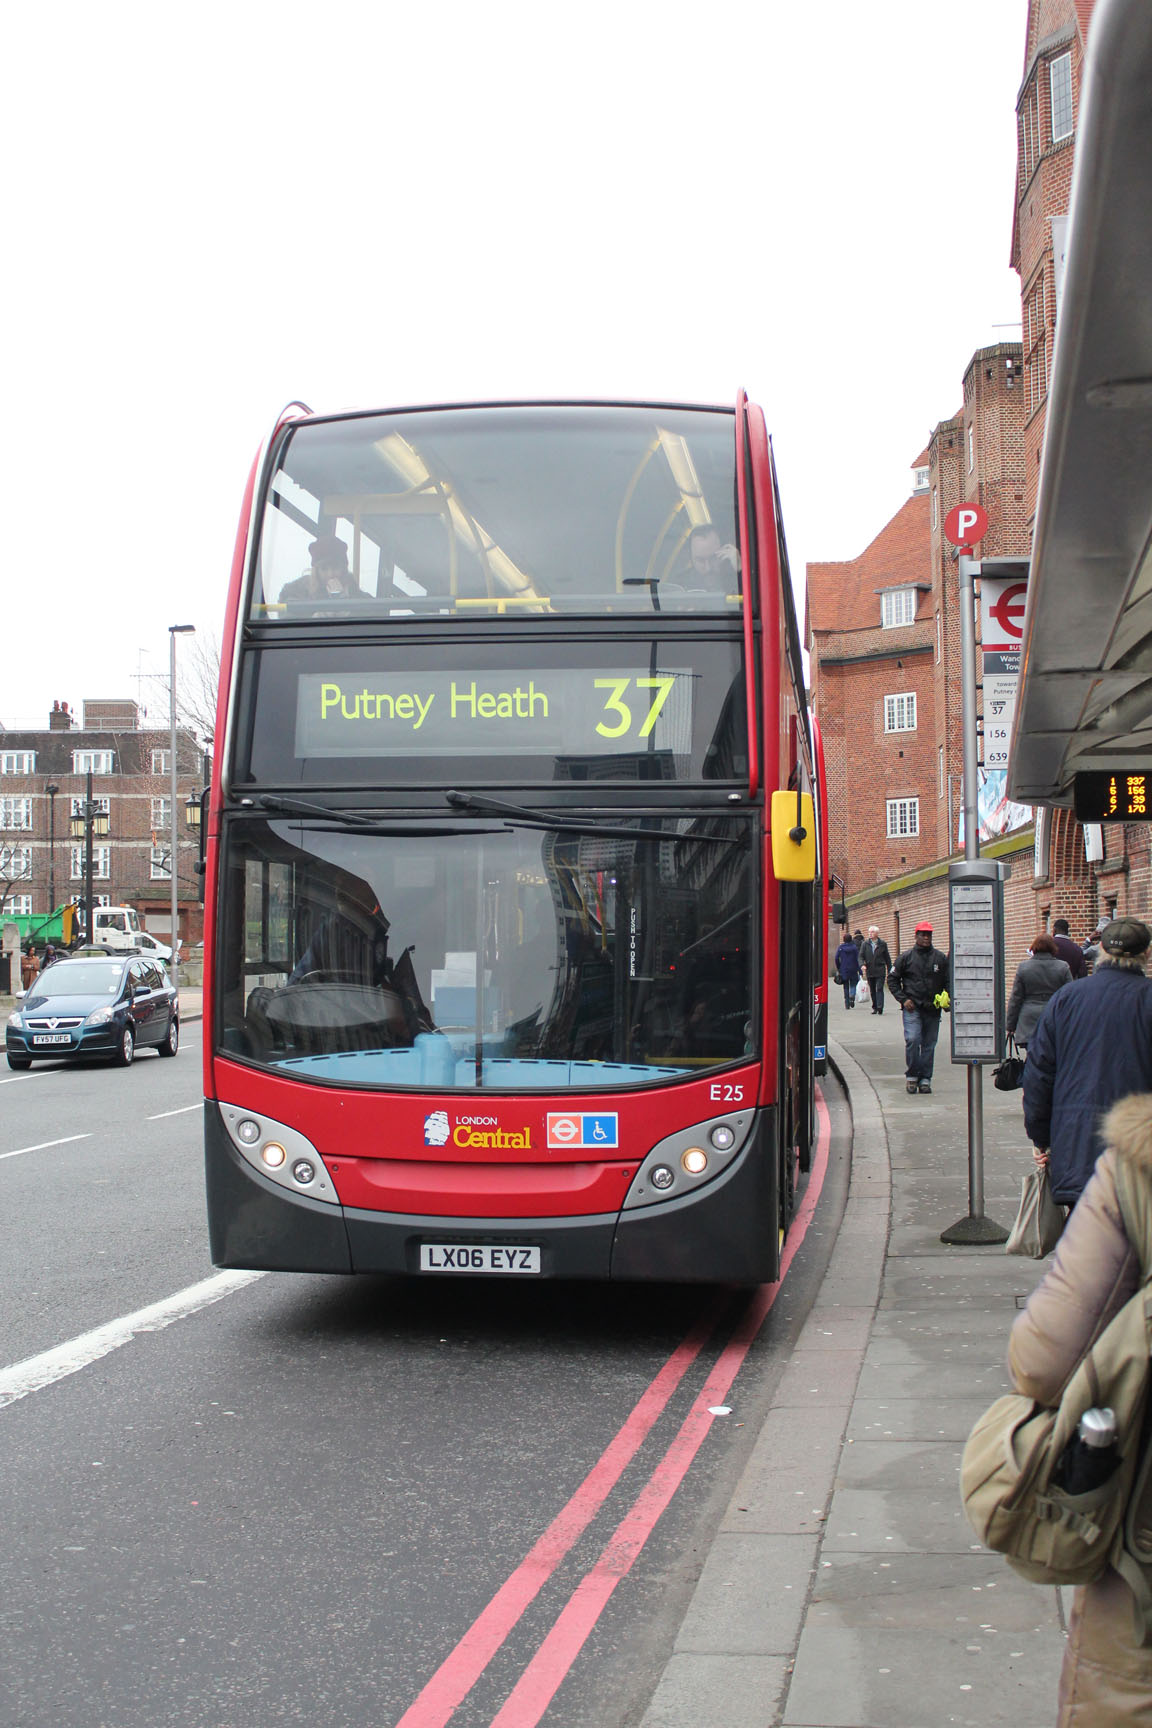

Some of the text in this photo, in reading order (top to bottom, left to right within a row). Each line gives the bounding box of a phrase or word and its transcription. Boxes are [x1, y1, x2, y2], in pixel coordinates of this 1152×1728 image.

[957, 510, 978, 538] P
[320, 677, 676, 739] Putney Heath 37
[991, 706, 1004, 715] 37
[989, 729, 1007, 738] 156
[989, 752, 1008, 762] 639
[1111, 776, 1145, 785] 1 337
[1128, 786, 1145, 795] 156
[1110, 795, 1145, 804] 6 39
[1110, 805, 1145, 813] 7 170
[630, 935, 636, 949] TO
[709, 1084, 744, 1102] E25
[455, 1115, 498, 1126] LONDON
[453, 1125, 532, 1149] Central
[428, 1248, 532, 1270] LX06 EYZ
